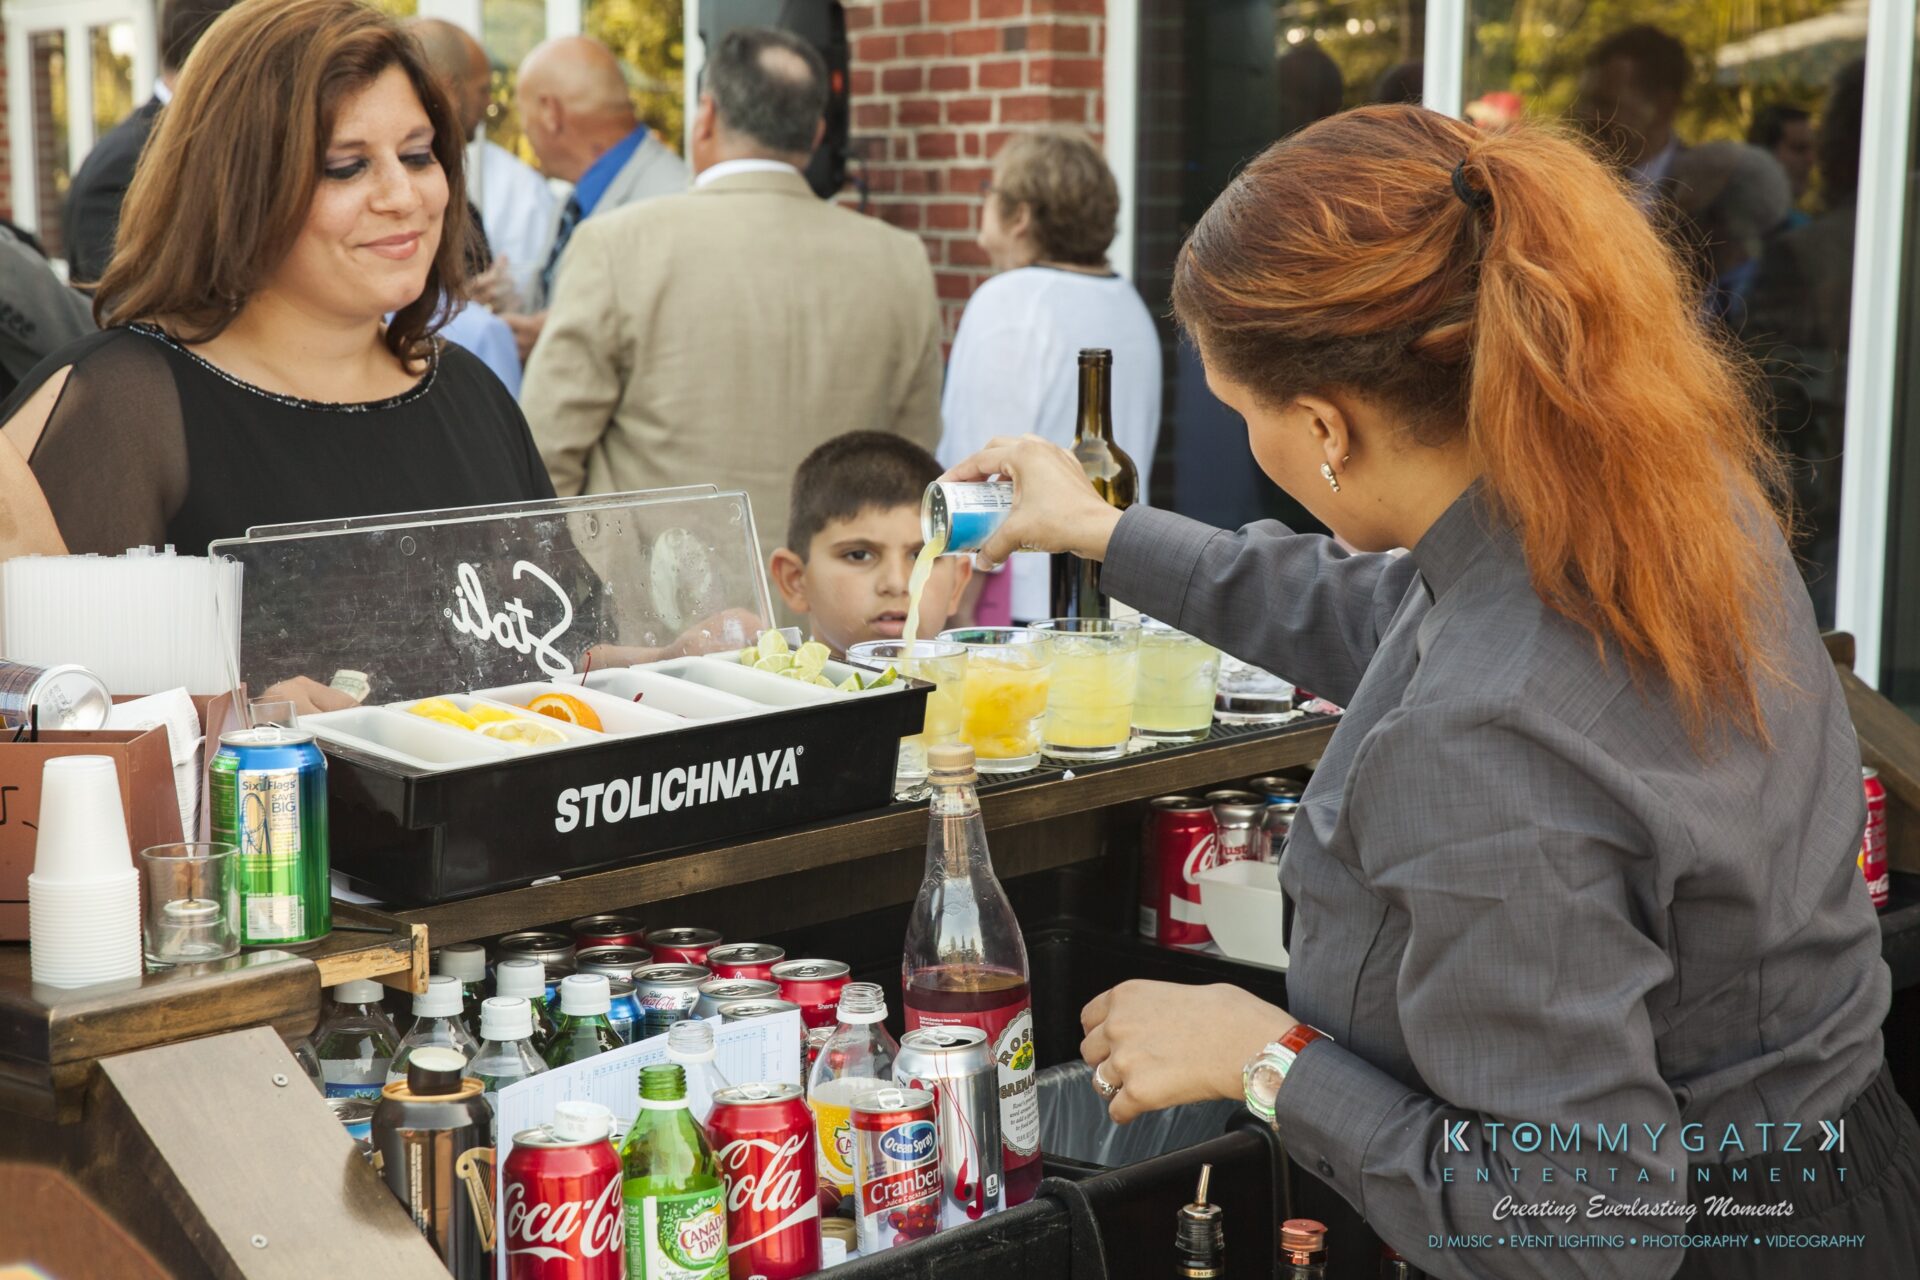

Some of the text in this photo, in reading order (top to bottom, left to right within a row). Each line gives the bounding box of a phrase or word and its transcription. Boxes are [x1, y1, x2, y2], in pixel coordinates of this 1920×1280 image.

[242, 780, 296, 792] Six Flags
[555, 747, 799, 833] STOLICHNAYA
[272, 793, 296, 802] SAVE
[272, 801, 296, 814] BIG
[884, 1131, 934, 1154] Ocean Spray
[871, 1169, 939, 1204] Cranber
[885, 1198, 903, 1208] Juice
[699, 1231, 722, 1254] DRY
